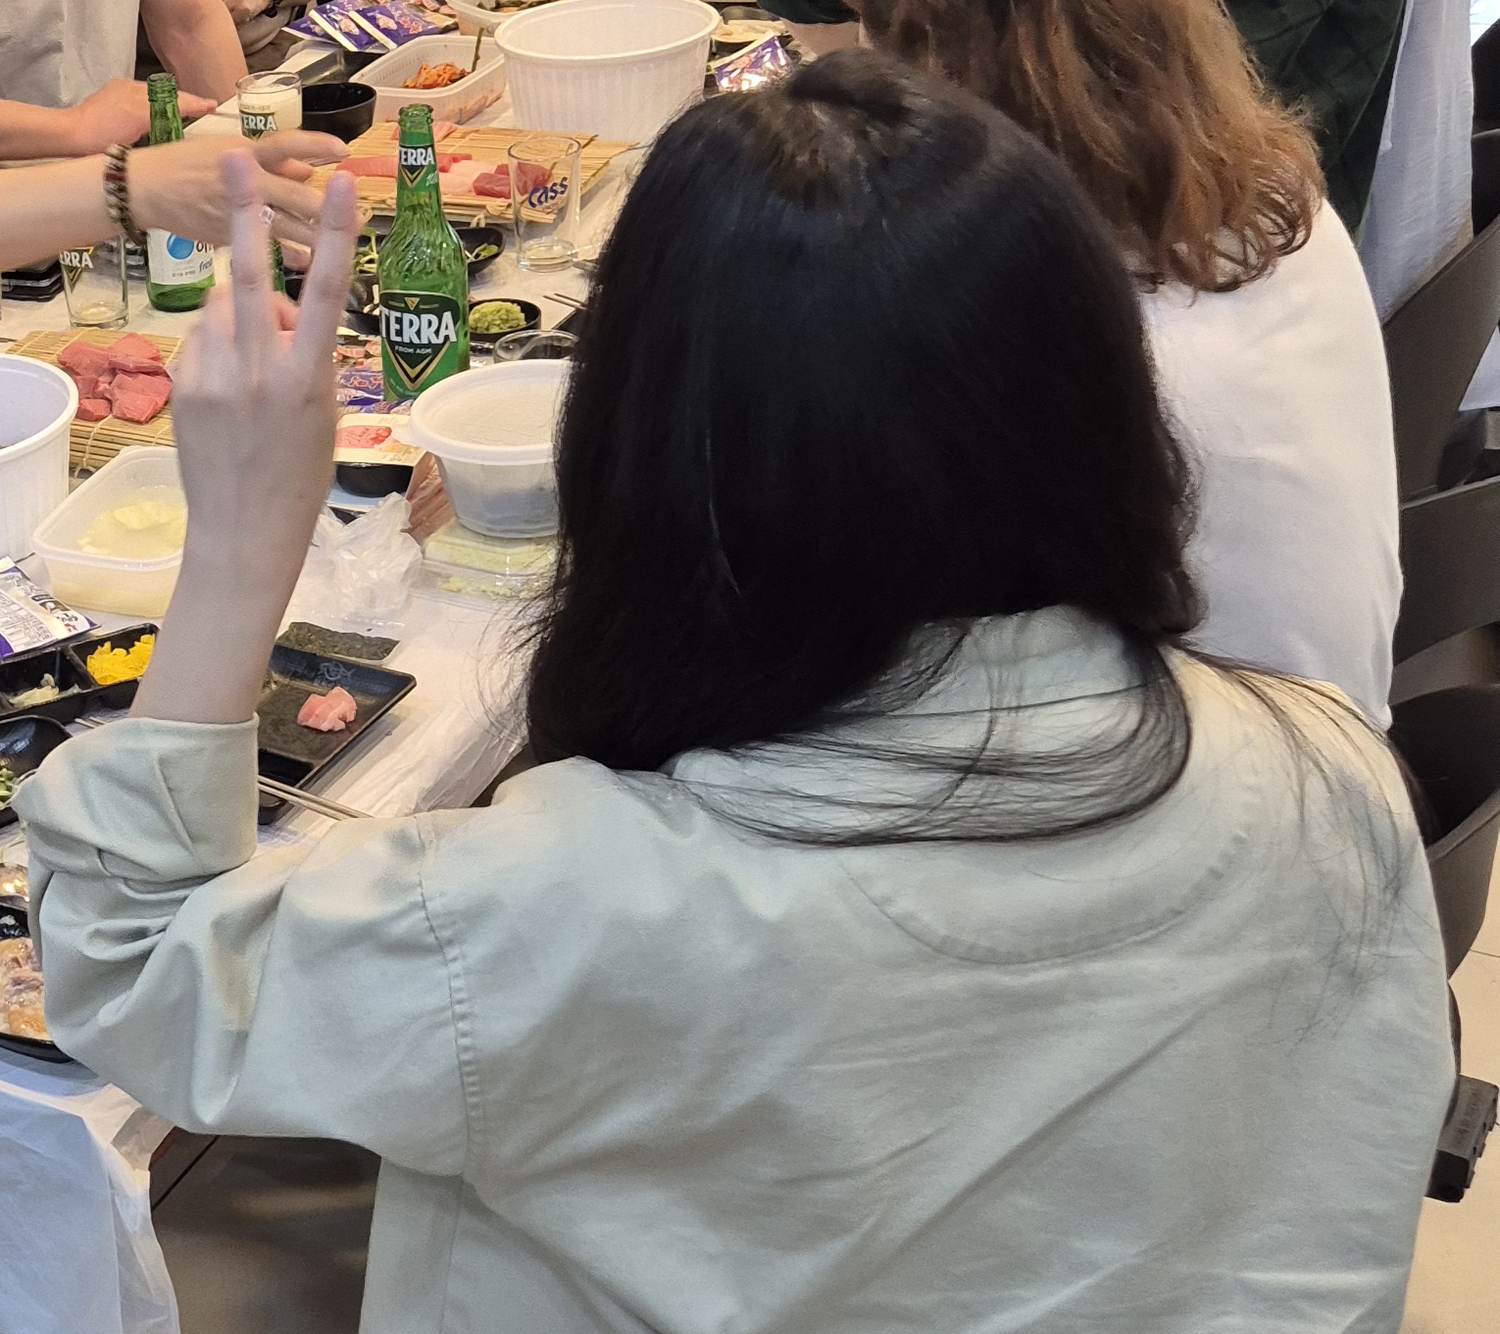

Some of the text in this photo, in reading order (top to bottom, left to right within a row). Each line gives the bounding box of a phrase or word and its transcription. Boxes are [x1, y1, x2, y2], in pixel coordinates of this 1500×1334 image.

[399, 146, 435, 167] TERRA
[380, 305, 457, 345] TERRA
[395, 346, 432, 355] FROM AGM
